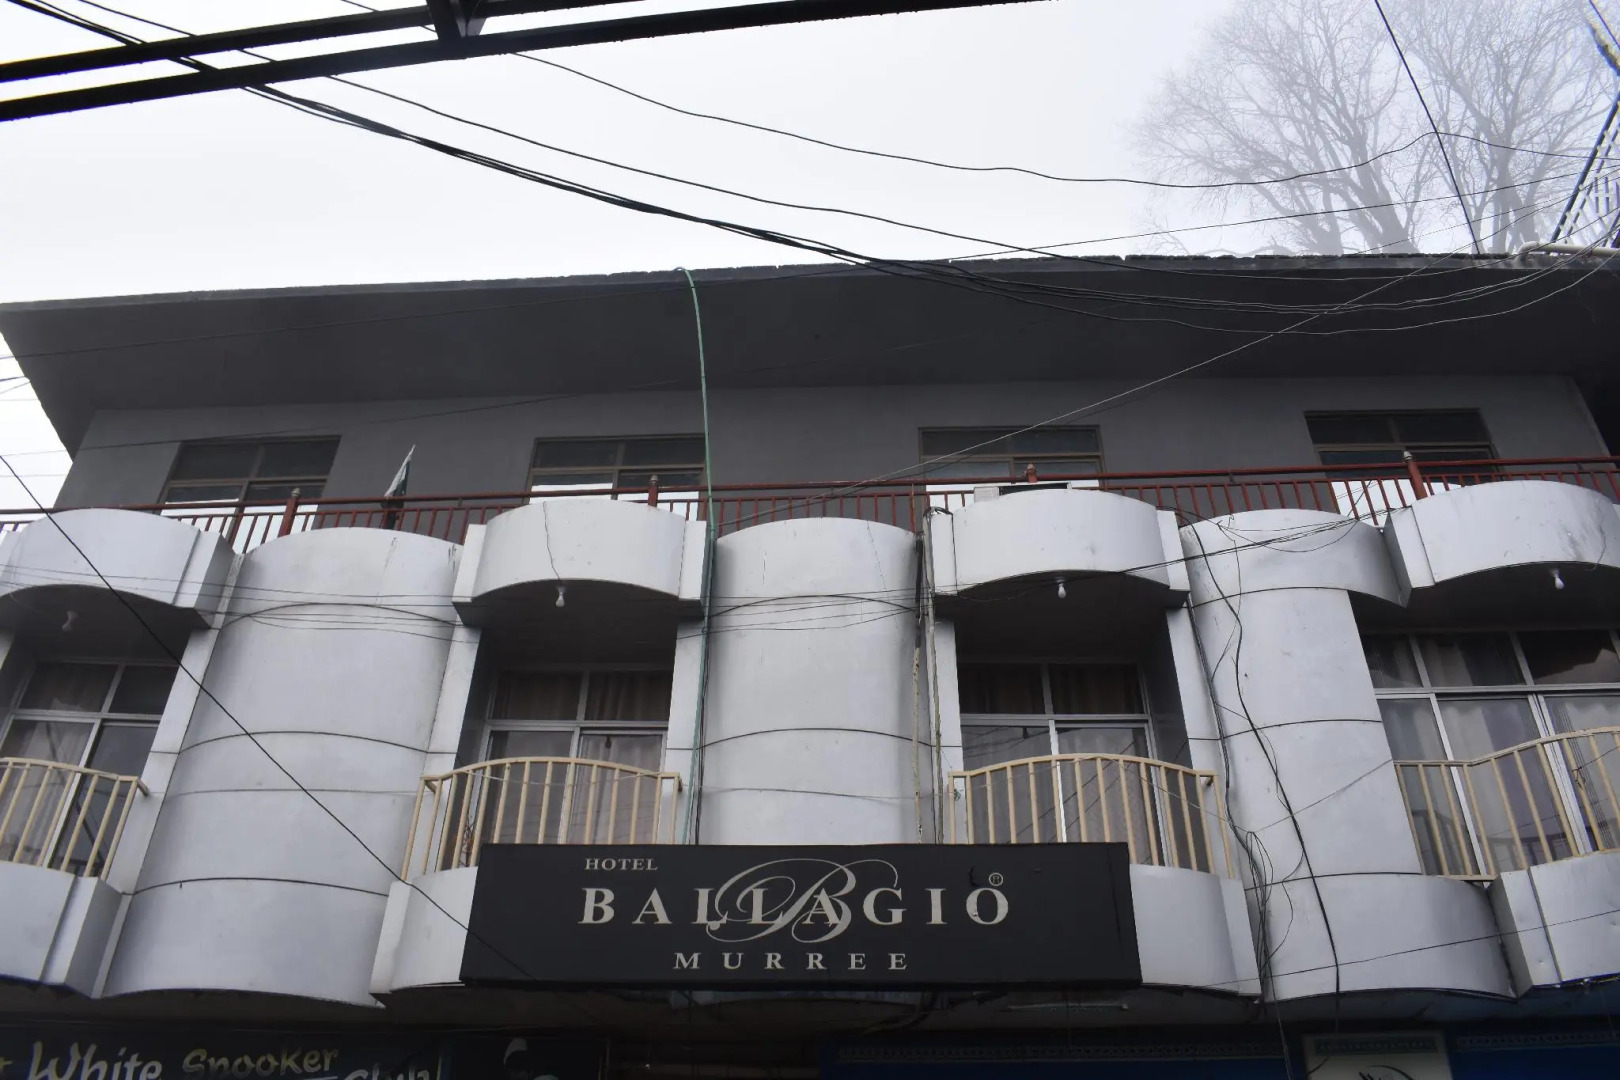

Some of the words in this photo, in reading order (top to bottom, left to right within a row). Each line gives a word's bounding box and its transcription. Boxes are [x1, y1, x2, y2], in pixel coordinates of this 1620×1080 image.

[584, 857, 659, 872] HOTEL
[577, 886, 1010, 925] BALLAGIO
[672, 951, 908, 971] MURREE
[182, 1046, 340, 1079] Snooker
